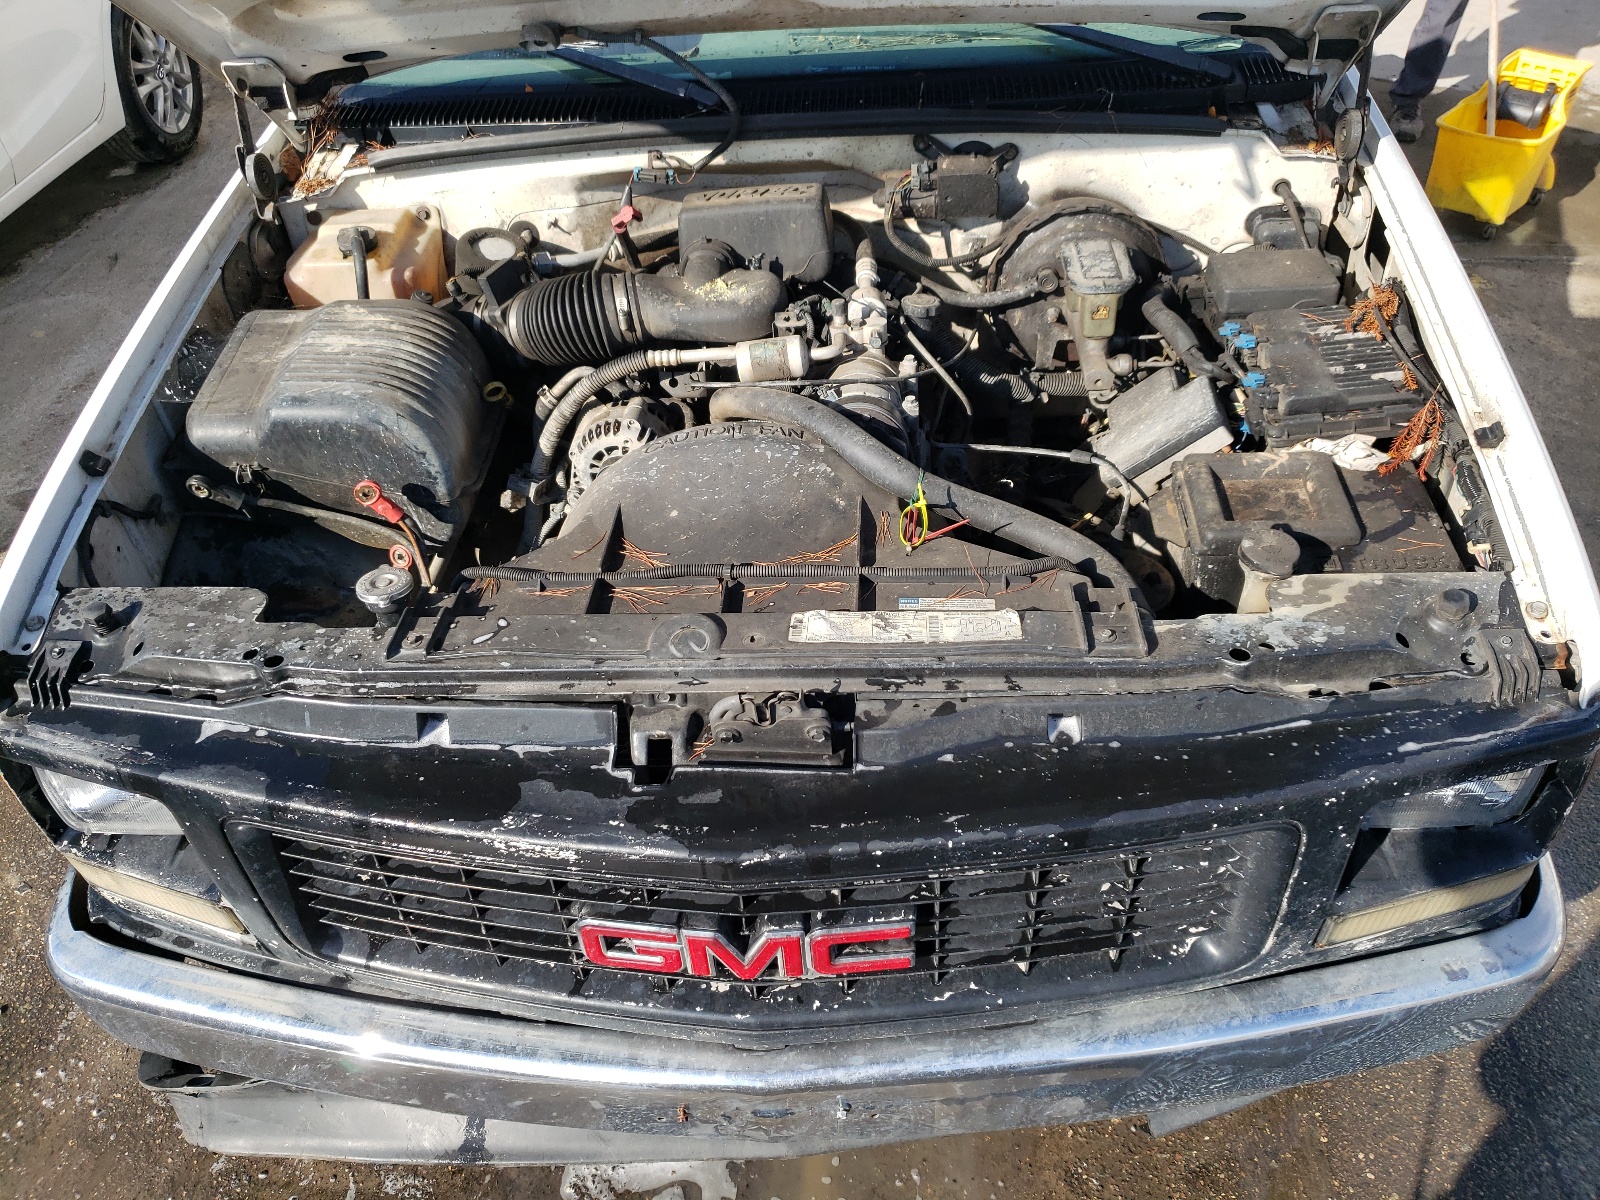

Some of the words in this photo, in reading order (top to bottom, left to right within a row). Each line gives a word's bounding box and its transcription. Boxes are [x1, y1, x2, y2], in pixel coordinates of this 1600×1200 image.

[644, 423, 743, 454] CAUTION
[758, 424, 805, 440] FAN
[577, 916, 915, 981] GMC
